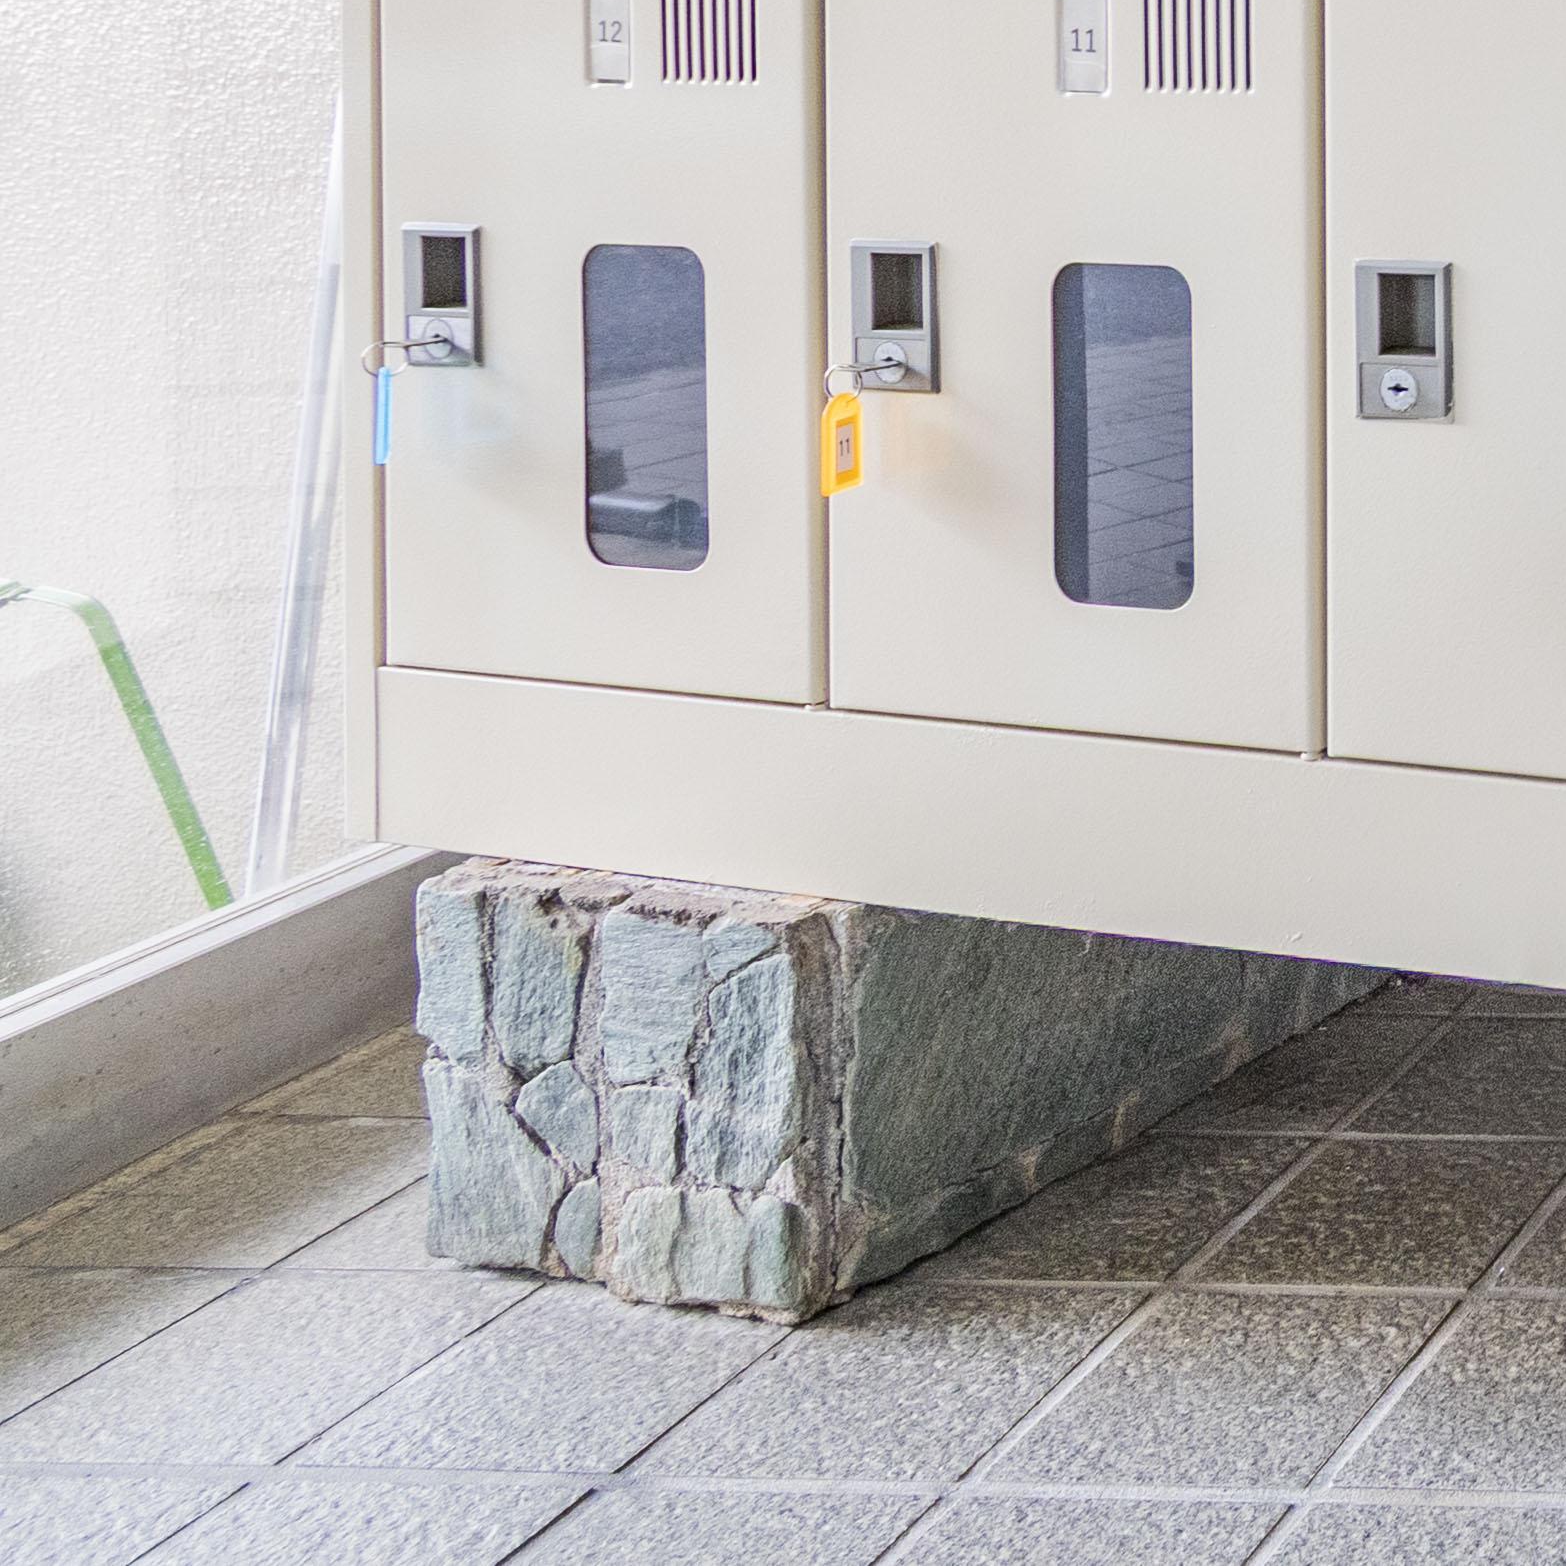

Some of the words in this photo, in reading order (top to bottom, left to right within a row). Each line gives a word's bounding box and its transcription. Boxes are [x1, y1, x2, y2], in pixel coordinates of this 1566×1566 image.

[599, 20, 622, 44] 12
[1070, 28, 1097, 53] 11
[840, 438, 850, 456] 11
